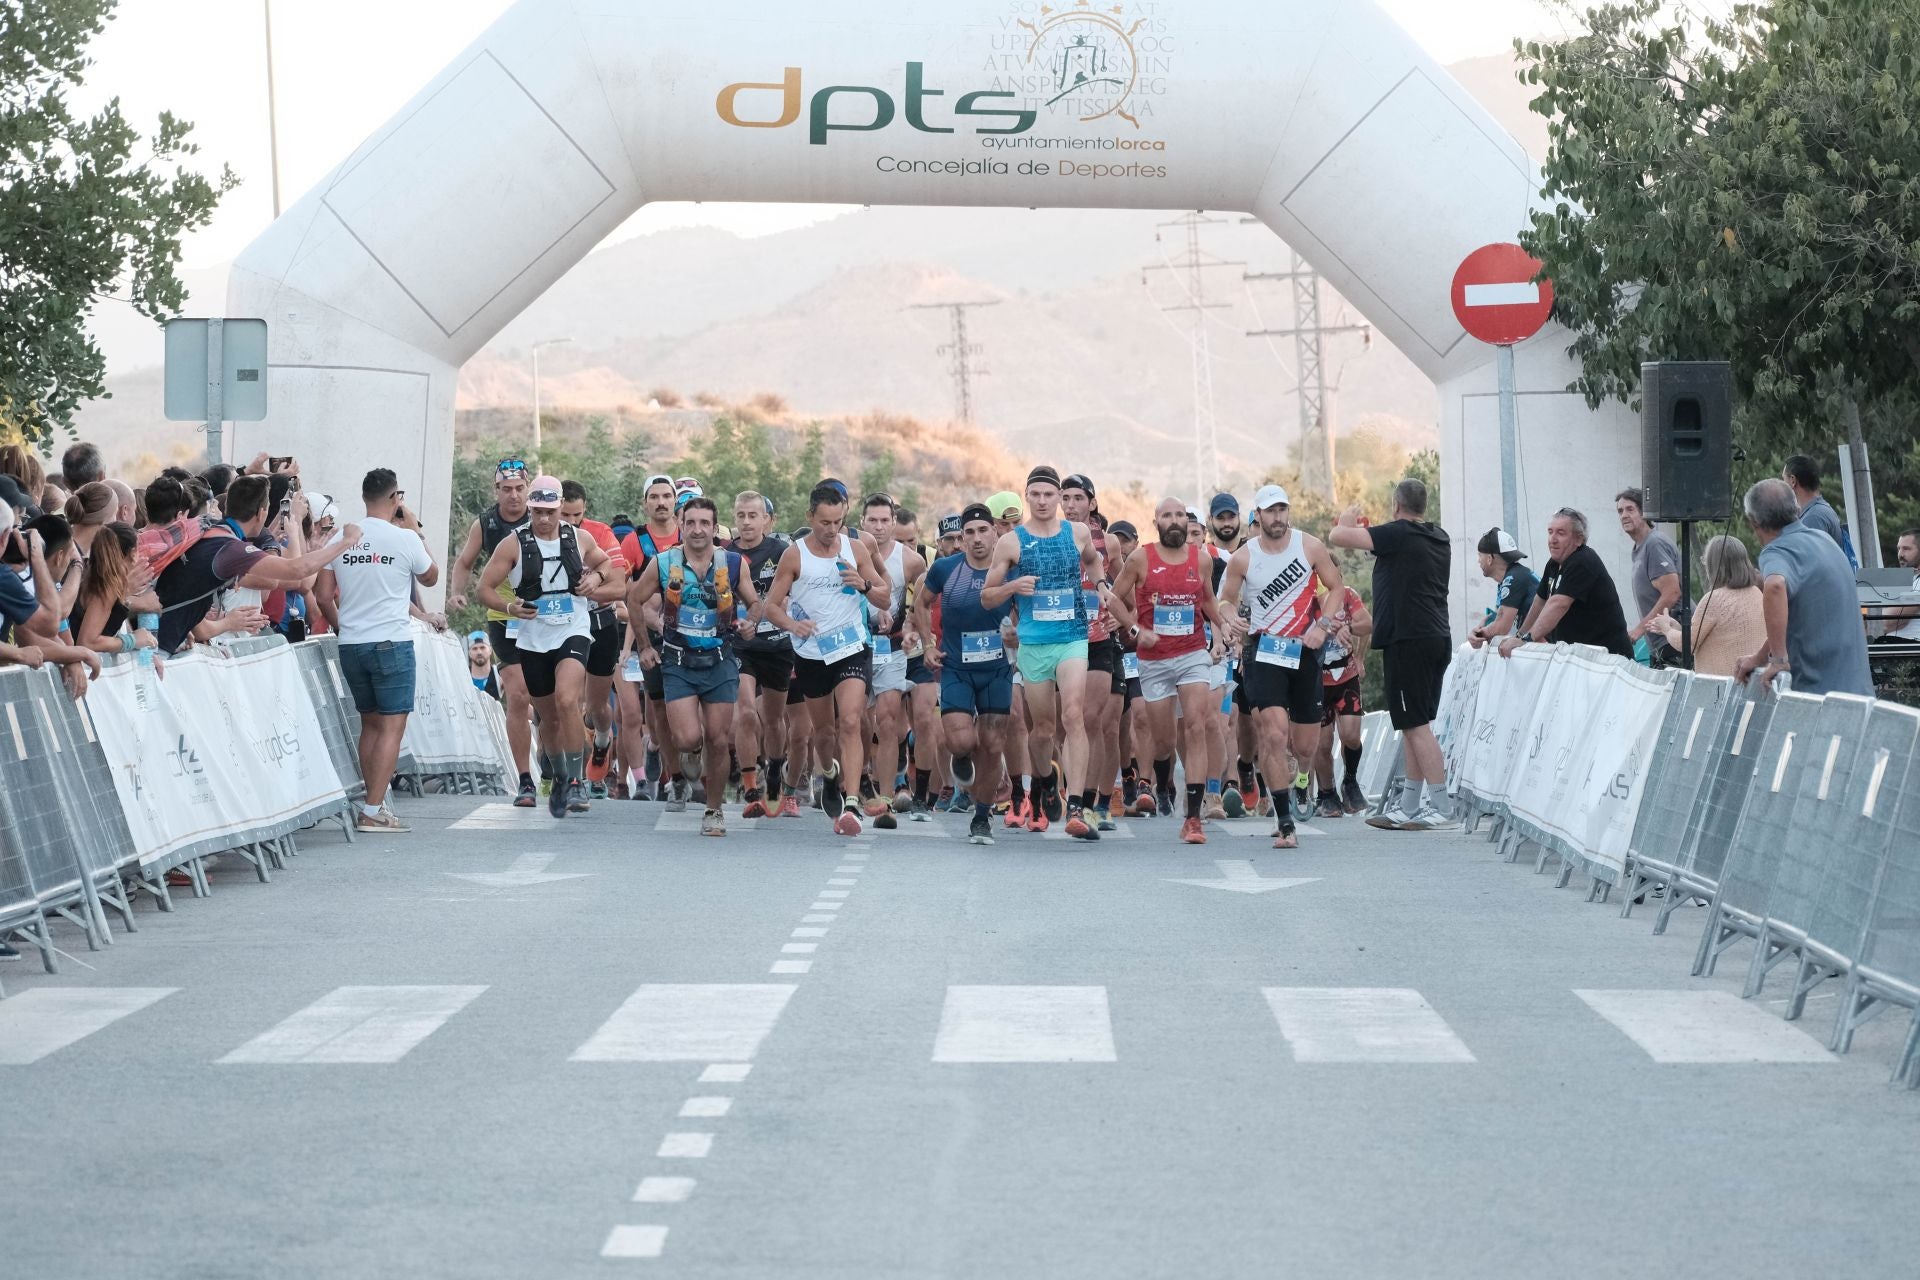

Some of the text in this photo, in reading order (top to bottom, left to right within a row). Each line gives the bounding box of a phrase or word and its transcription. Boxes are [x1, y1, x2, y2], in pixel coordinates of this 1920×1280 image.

[715, 61, 1038, 146] dpts
[876, 154, 1167, 180] Concejalía de Deportes
[342, 553, 396, 566] Speaker
[547, 600, 561, 611] 45
[1047, 595, 1060, 606] 35
[692, 614, 706, 624] 64
[1168, 612, 1182, 622] 69
[831, 631, 846, 646] 74
[976, 636, 990, 648] 43
[1273, 640, 1287, 651] 39
